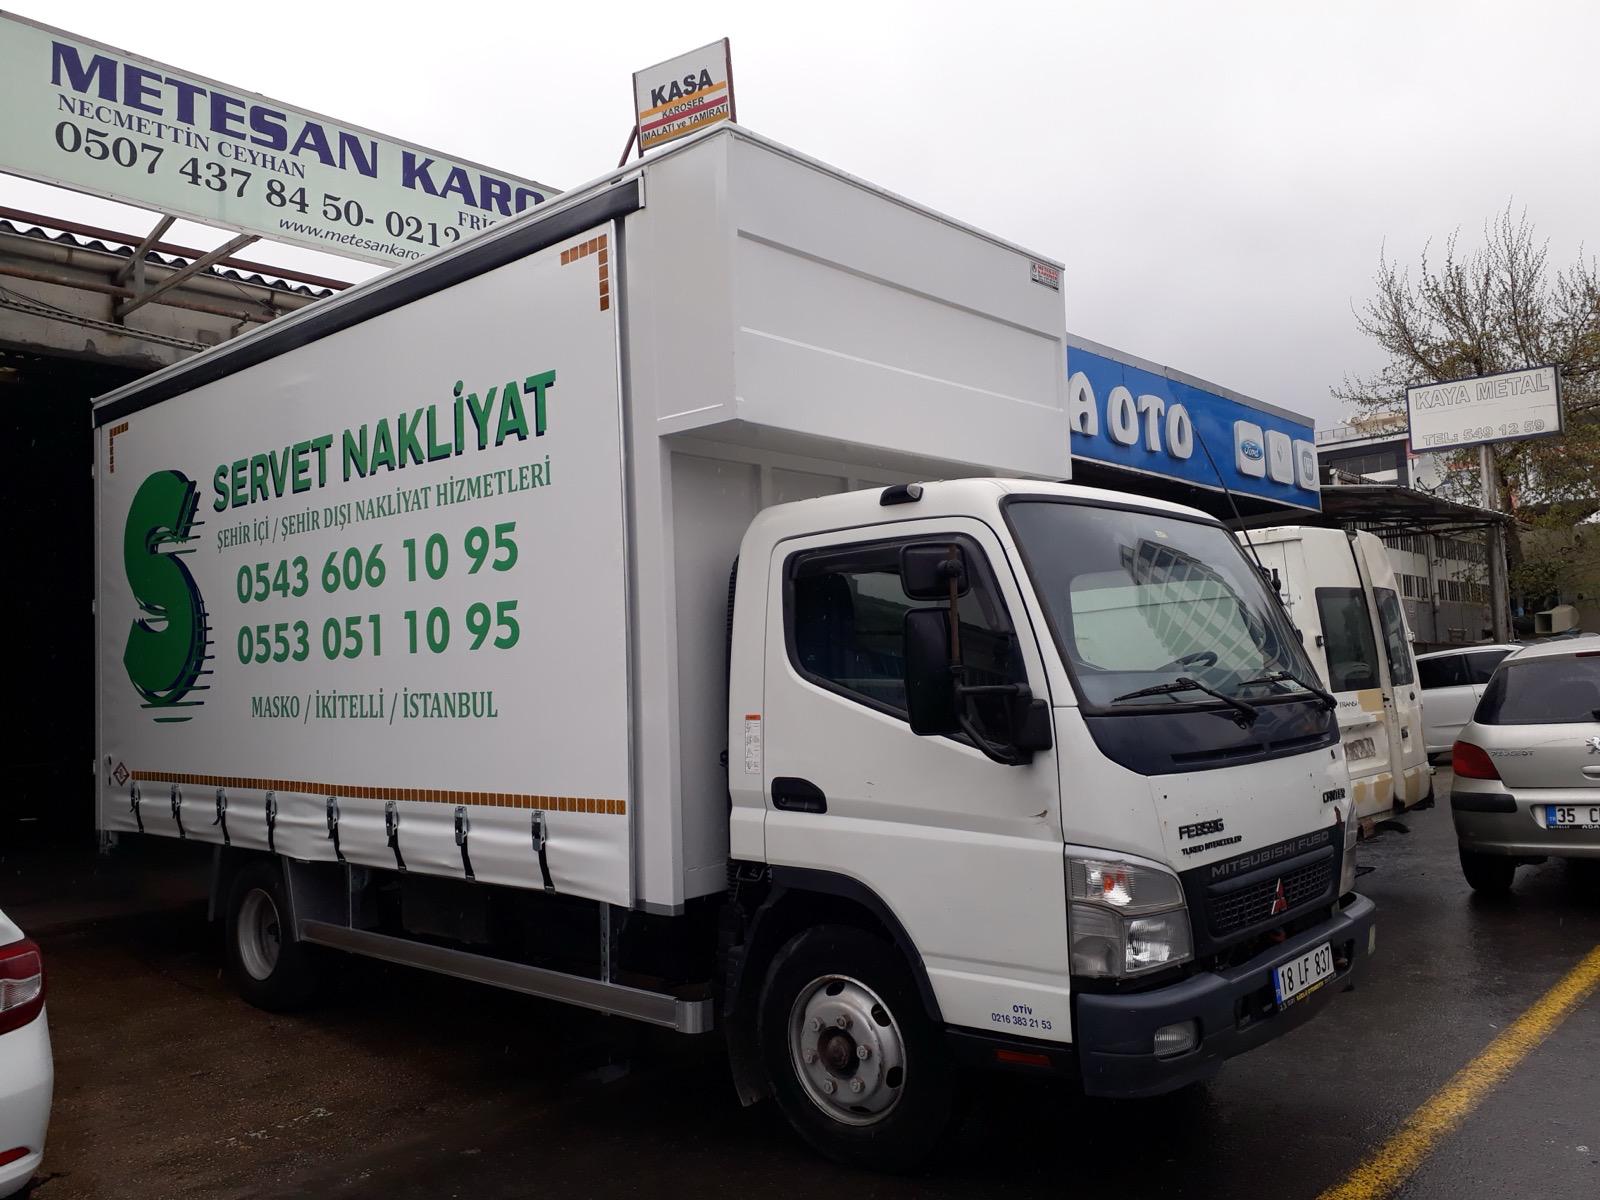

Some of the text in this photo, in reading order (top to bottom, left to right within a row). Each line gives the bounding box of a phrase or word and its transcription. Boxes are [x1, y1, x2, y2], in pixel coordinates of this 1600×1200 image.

[51, 40, 378, 179] METESAN
[651, 69, 713, 108] KASA
[662, 97, 704, 119] KAROSER
[676, 120, 687, 128] ve
[55, 121, 164, 174] 0507
[179, 157, 252, 198] 437
[265, 179, 309, 214] 84
[217, 141, 306, 179] CEYHAN
[279, 218, 425, 260] www.metesankaro
[1415, 374, 1549, 409] KAYA METAL
[213, 369, 556, 513] SERVET NAKLİYAT
[1107, 385, 1193, 459] OTO
[1422, 419, 1544, 446] TEL: 549 12 59
[217, 455, 551, 553] ŞEHİR İÇİ / ŞEHİR DIŞI NAKLİYAT HİZMETLERİ
[236, 521, 519, 604] 0543 606 10 95
[237, 600, 520, 665] 0553 051 10 95
[251, 687, 498, 726] MASKO / İKİTELLİ / İSTANBUL
[1557, 808, 1600, 823] 35 C
[1211, 831, 1329, 879] MITSUBISHI FUSO
[1281, 967, 1294, 995] 18
[1298, 957, 1309, 985] LF
[1314, 946, 1330, 976] 837
[991, 1012, 1052, 1030] 0216 383 21 53
